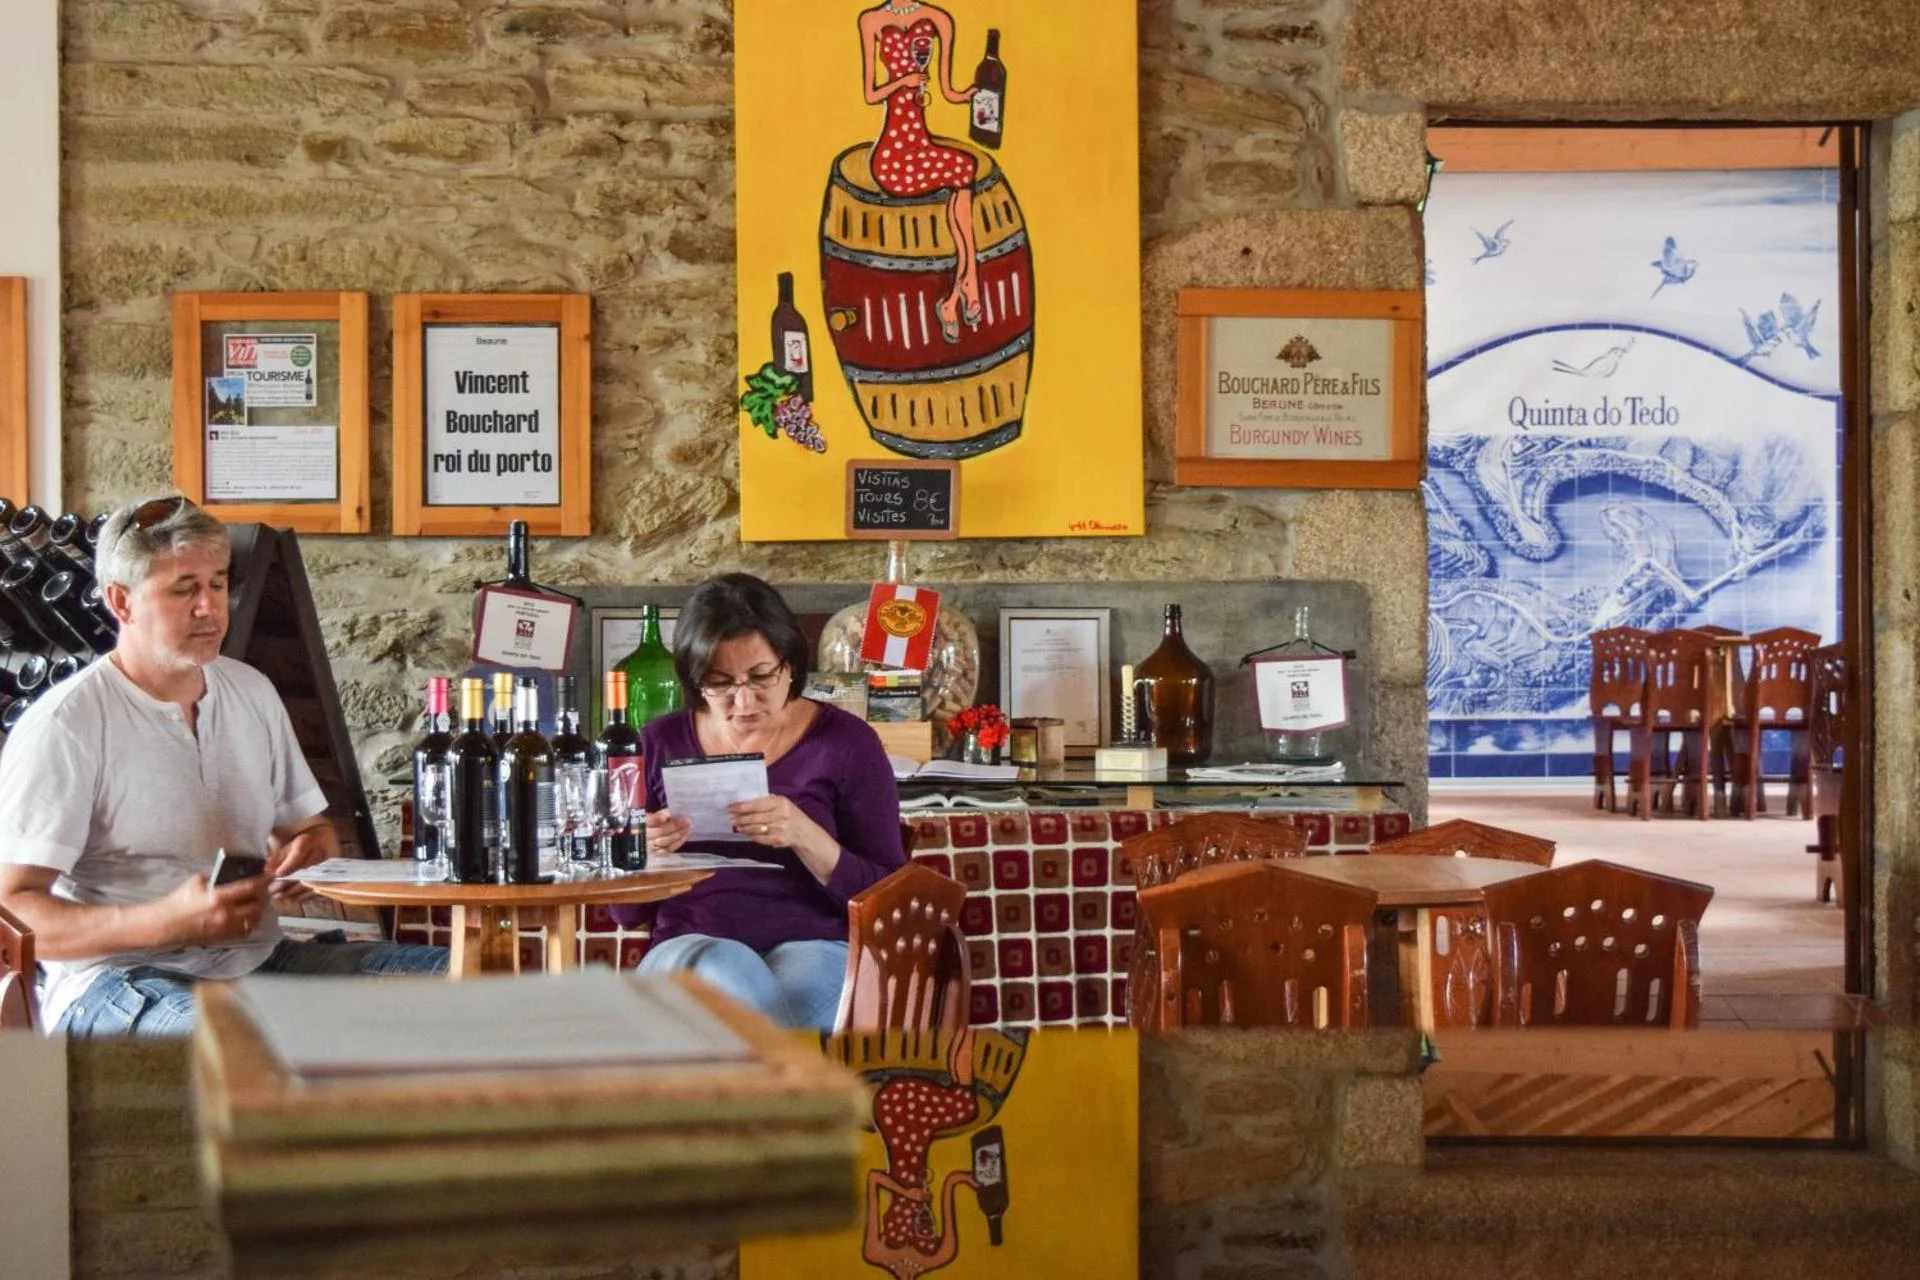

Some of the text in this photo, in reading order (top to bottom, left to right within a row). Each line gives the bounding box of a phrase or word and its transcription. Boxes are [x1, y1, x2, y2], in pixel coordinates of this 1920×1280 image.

[476, 337, 508, 345] Beaune
[246, 371, 305, 382] TOURISME
[455, 371, 530, 394] Vincent
[1218, 371, 1300, 395] BOUCHARD
[446, 409, 540, 434] Bouchard
[1508, 395, 1680, 431] Quinta do Tedo
[1229, 423, 1363, 447] BURGUNDY WINES
[433, 449, 553, 477] roi du porto
